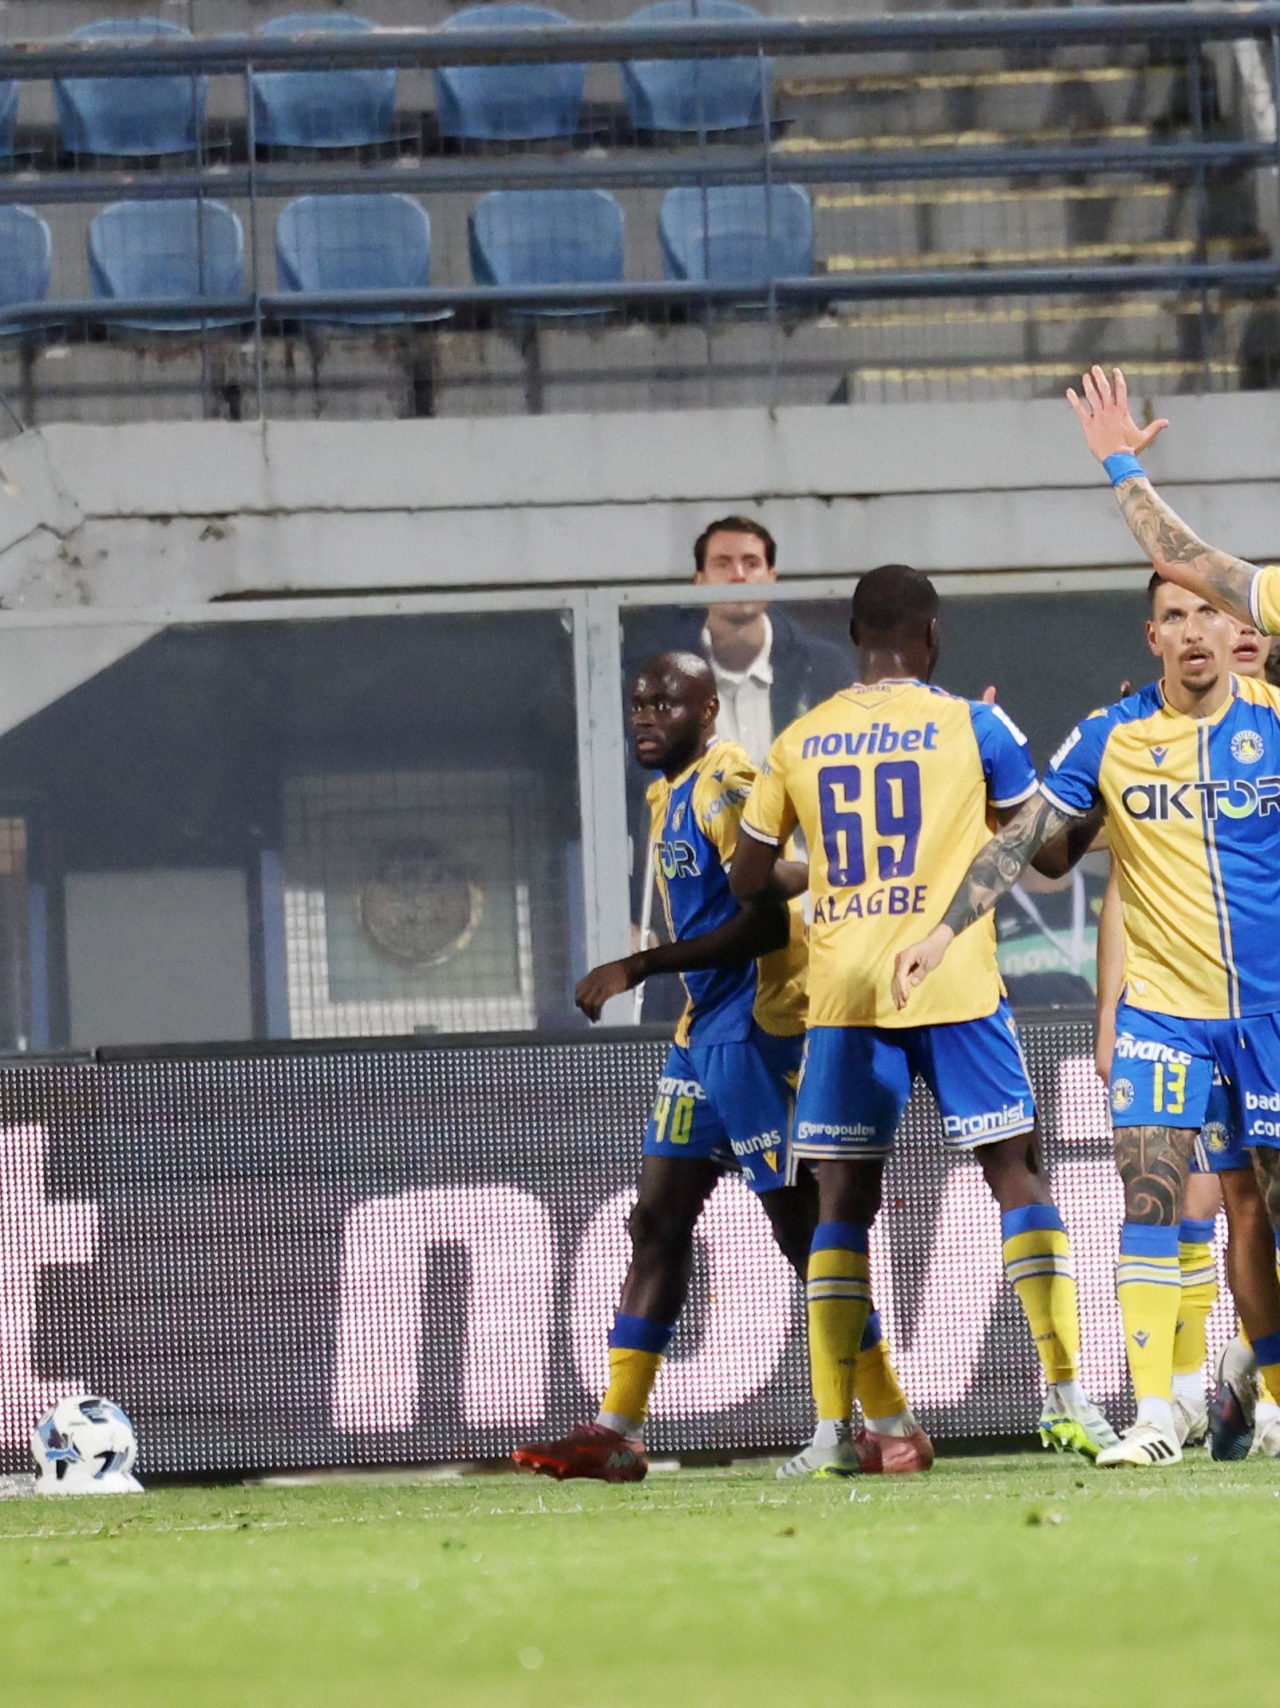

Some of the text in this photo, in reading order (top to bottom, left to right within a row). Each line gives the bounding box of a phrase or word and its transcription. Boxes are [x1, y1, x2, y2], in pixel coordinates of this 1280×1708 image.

[802, 721, 939, 759] novibet
[818, 760, 923, 887] 69
[813, 885, 928, 924] ALAGBE
[1153, 1062, 1187, 1115] 13
[653, 1096, 696, 1145] 40
[942, 1098, 1025, 1137] Promist
